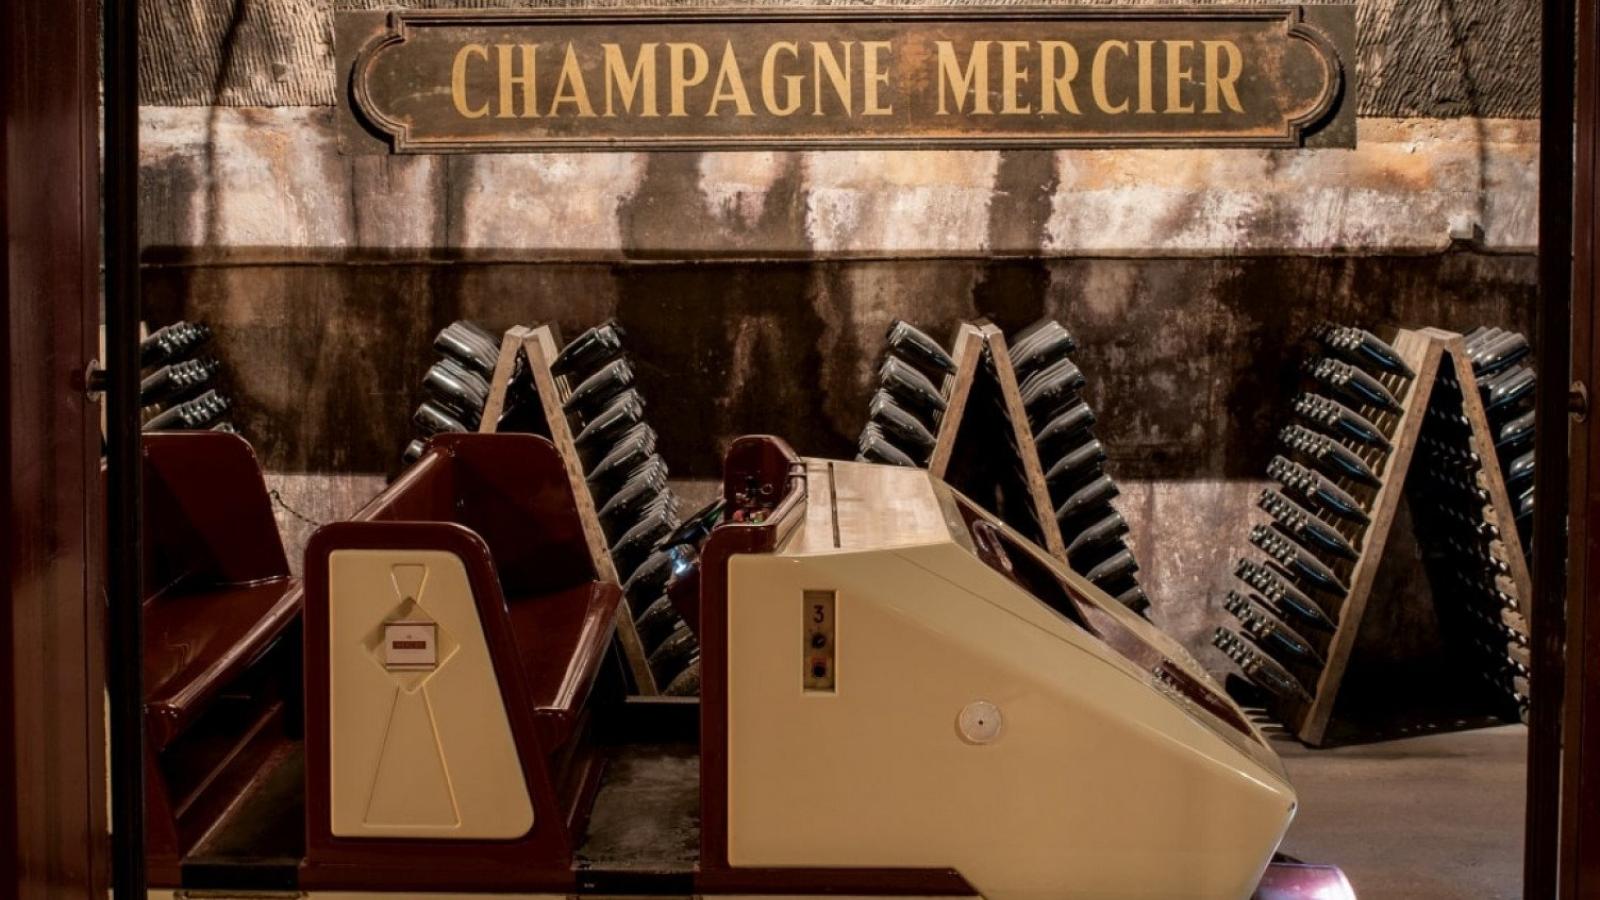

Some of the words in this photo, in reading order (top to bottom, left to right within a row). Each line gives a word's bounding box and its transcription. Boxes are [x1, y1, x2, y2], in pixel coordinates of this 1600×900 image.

[451, 41, 893, 119] CHAMPAGNE
[935, 40, 1245, 115] MERCIER
[813, 604, 824, 624] 3
